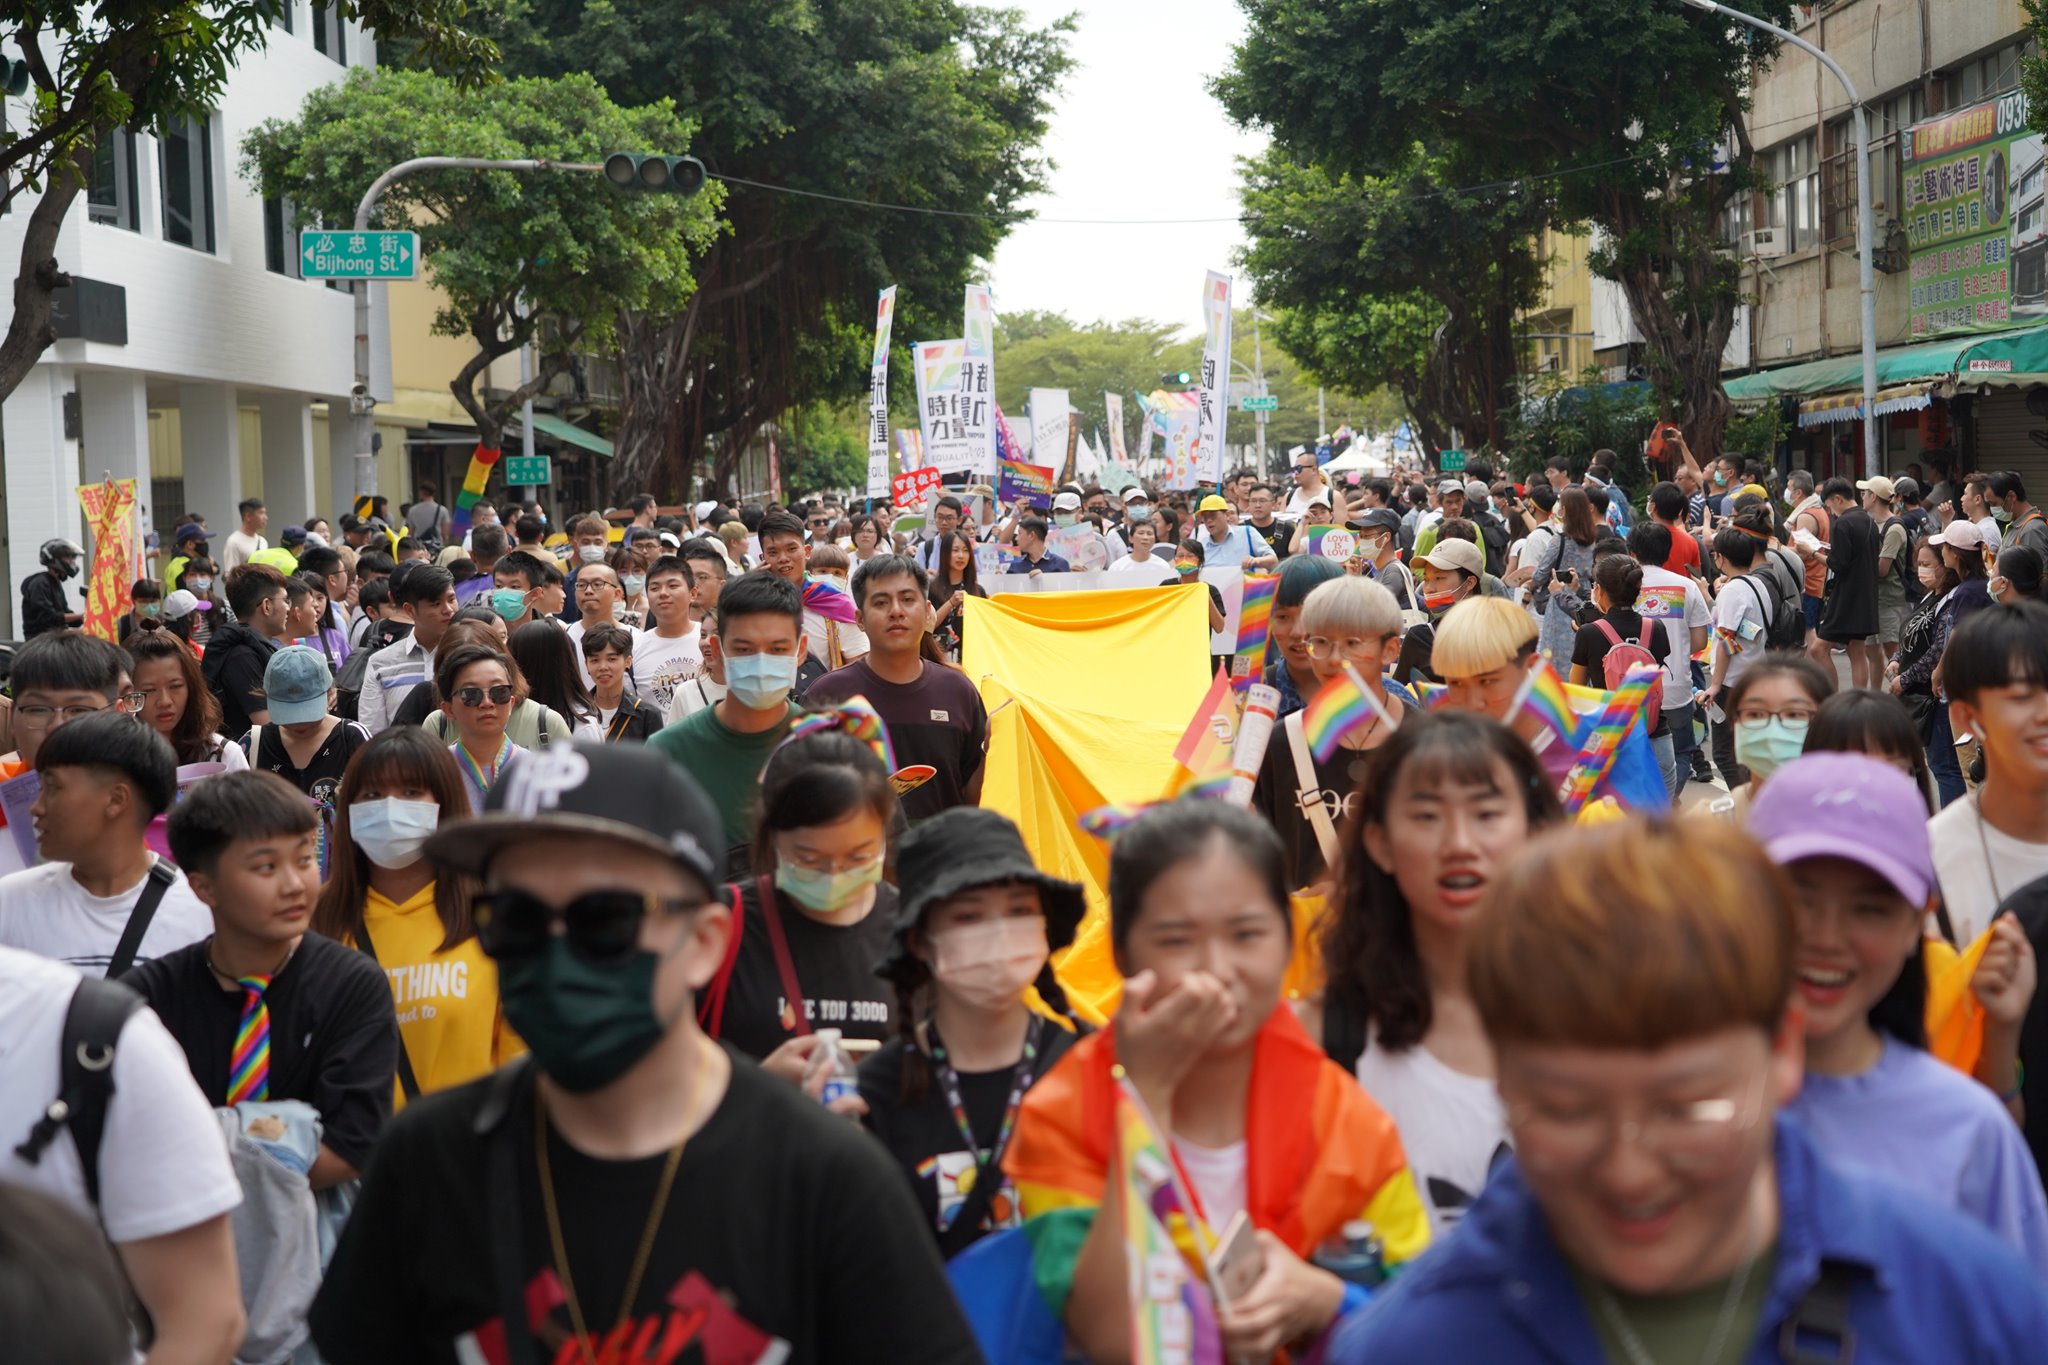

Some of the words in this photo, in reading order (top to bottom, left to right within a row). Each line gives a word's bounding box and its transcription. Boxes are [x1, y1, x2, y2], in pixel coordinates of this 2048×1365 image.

[315, 234, 399, 254] 必忠街
[315, 255, 374, 275] Bijhong
[380, 255, 399, 271] St.
[384, 960, 468, 1004] THING
[819, 999, 847, 1020] YOU
[851, 1000, 888, 1023] 3000
